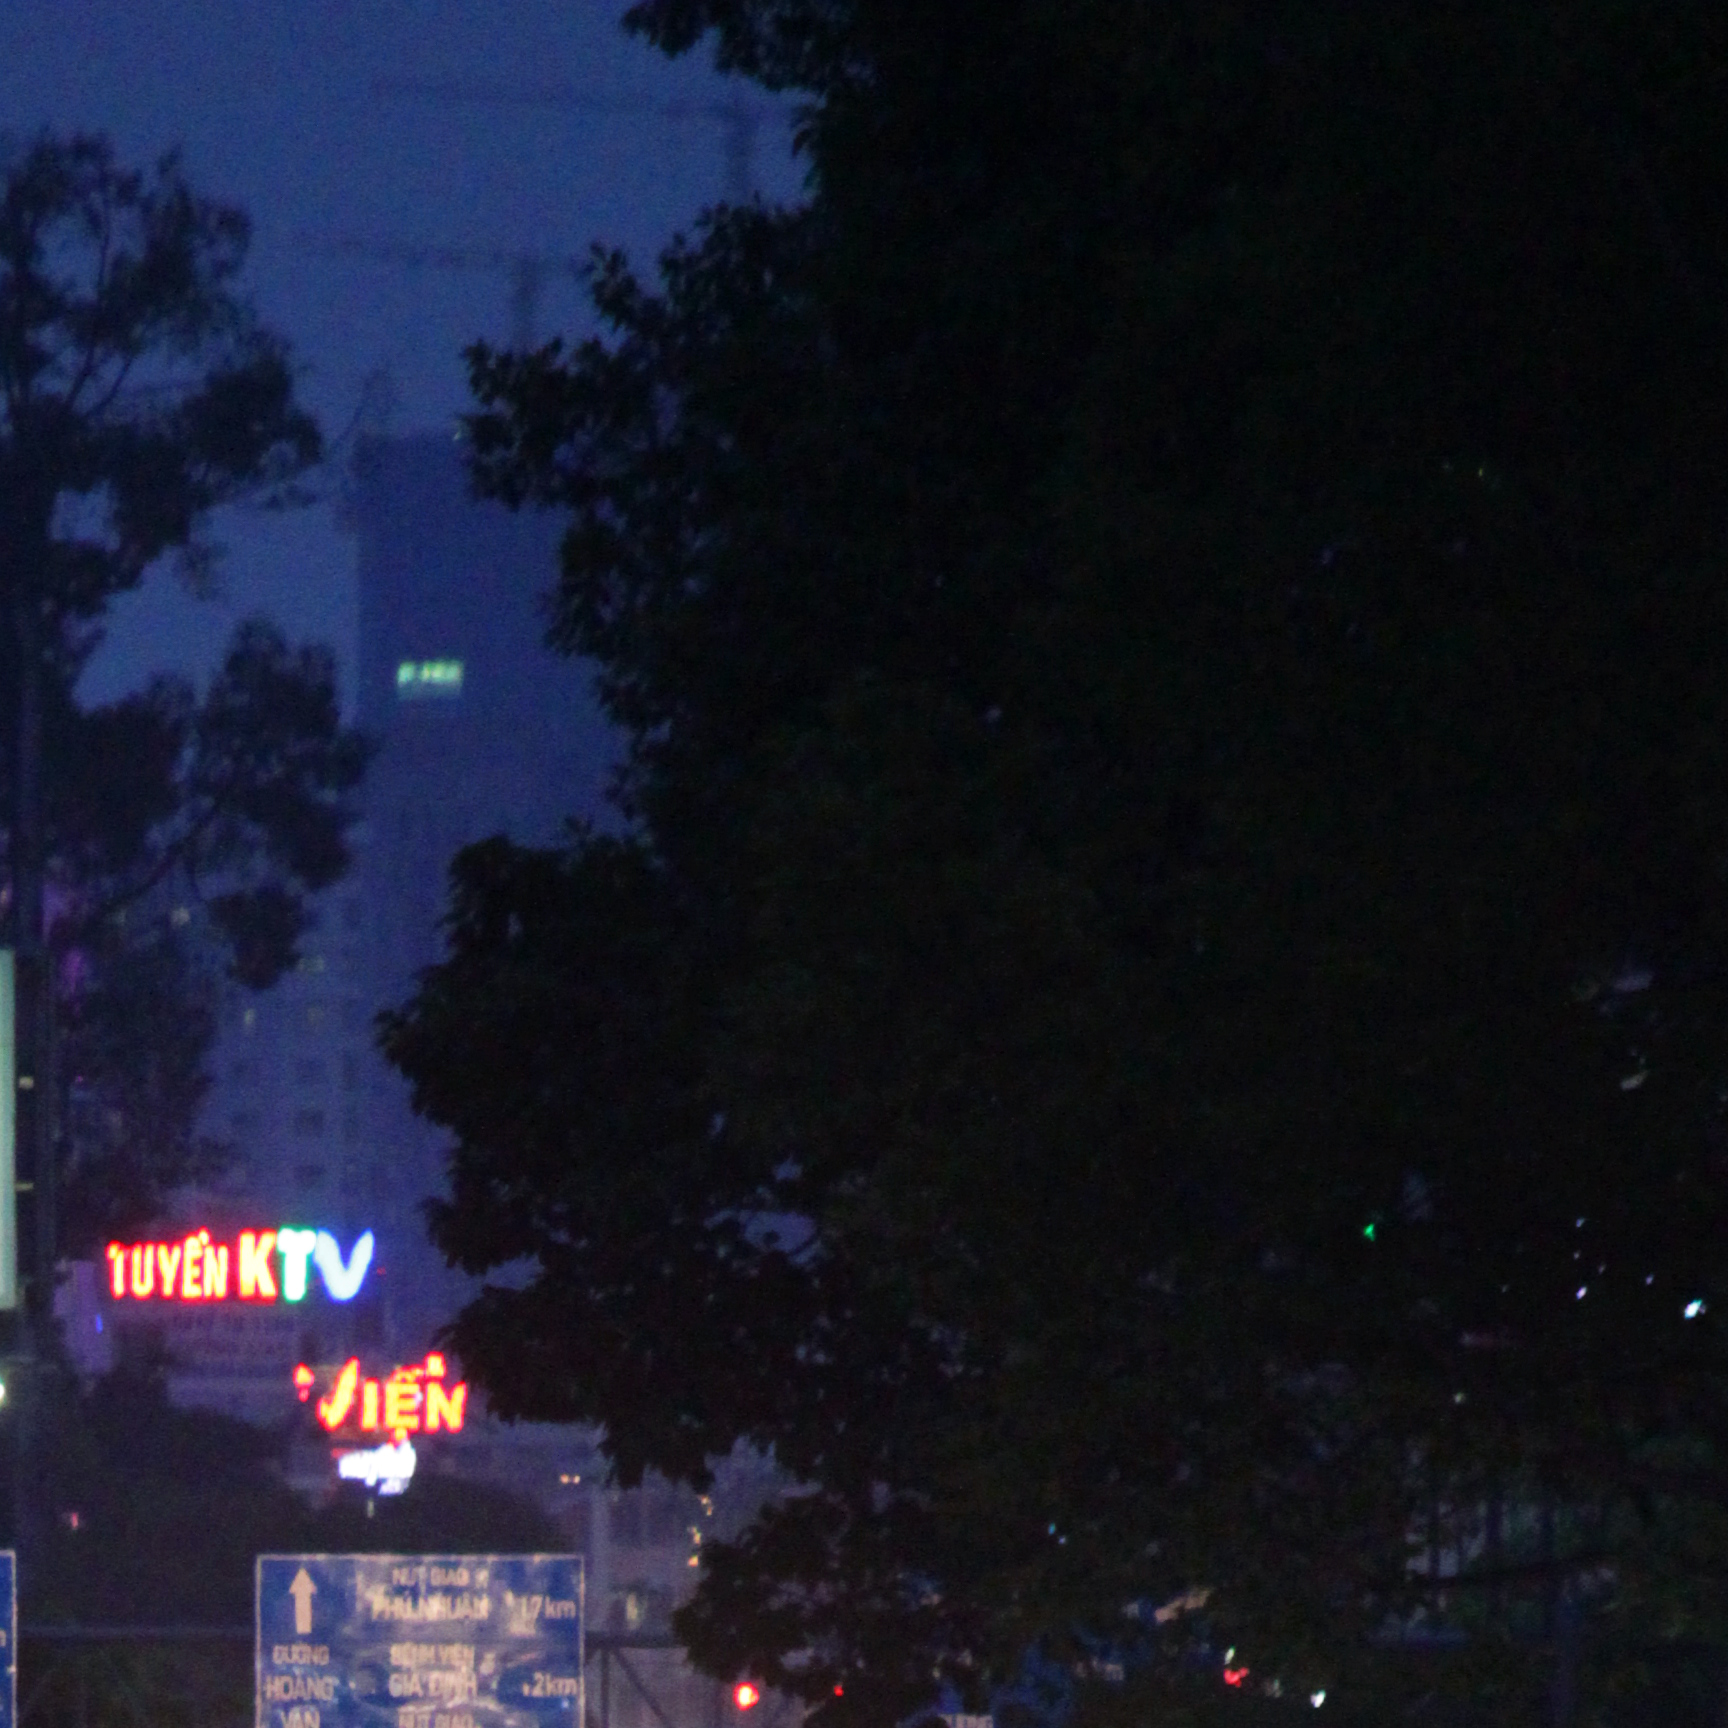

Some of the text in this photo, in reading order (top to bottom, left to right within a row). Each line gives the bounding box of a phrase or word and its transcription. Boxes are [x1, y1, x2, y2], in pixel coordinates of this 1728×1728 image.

[238, 1229, 373, 1301] KTV
[545, 1596, 576, 1619] km
[545, 1673, 577, 1697] km
